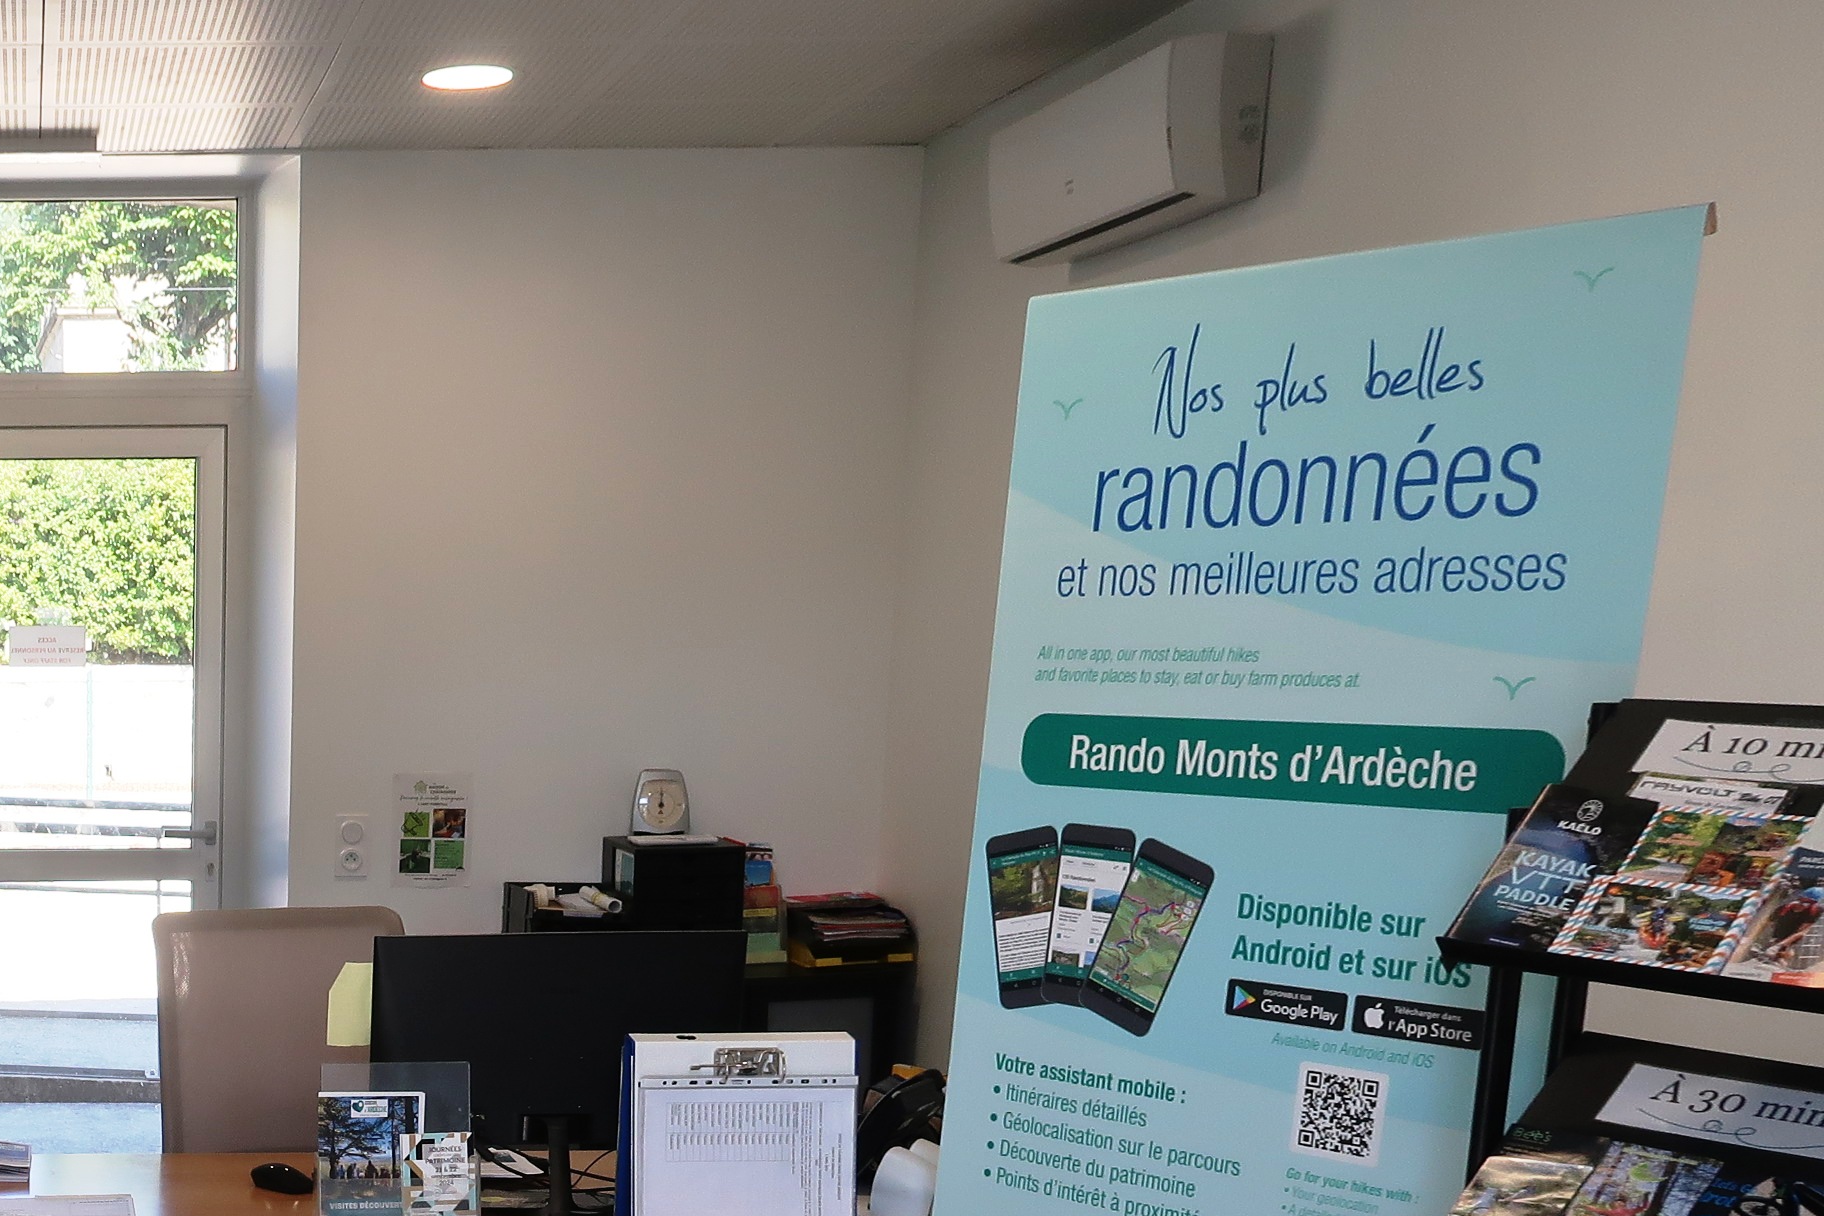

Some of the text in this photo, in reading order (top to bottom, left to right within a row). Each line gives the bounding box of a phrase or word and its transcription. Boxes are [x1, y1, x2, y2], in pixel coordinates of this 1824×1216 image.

[1151, 323, 1484, 438] Nos plus belles
[1092, 423, 1541, 532] randonnées
[1057, 547, 1567, 598] et nos meilleures adresses
[1037, 645, 1260, 664] All in one app, our most beautiful hikes
[1035, 667, 1057, 682] and
[1058, 667, 1098, 683] favorite
[1100, 668, 1136, 685] places
[1139, 669, 1150, 684] to
[1183, 670, 1203, 685] eat
[1205, 671, 1219, 685] or
[1221, 670, 1245, 688] buy
[1247, 670, 1278, 687] farm
[1280, 671, 1341, 689] produces
[1682, 725, 1716, 753] À
[1721, 737, 1769, 756] 10
[1069, 734, 1477, 792] Rando Monts d'Ardèche
[1557, 820, 1602, 836] KAÉLO
[1514, 850, 1597, 878] KAYAK
[1512, 866, 1588, 894] VTT
[1493, 884, 1575, 911] PADDLE
[1237, 893, 1425, 938] Disponible sur
[1231, 935, 1472, 988] Android et sur iOS
[1260, 999, 1338, 1026] Google Play
[1394, 1005, 1440, 1021] Télécharger
[1271, 1032, 1320, 1052] Available
[1323, 1042, 1338, 1056] on
[1339, 1042, 1384, 1062] Android
[1386, 1047, 1411, 1064] and
[1430, 1024, 1473, 1043] Store
[996, 1052, 1035, 1076] Votre
[1039, 1064, 1113, 1091] assistant
[1117, 1077, 1175, 1102] mobile
[1006, 1083, 1148, 1128] Itinéraires détaillés
[1650, 1073, 1687, 1105] À
[1688, 1088, 1746, 1114] 30
[1003, 1110, 1241, 1177] Géolocalisation sur le parcours
[999, 1139, 1196, 1199] Découverte du patrimoine
[1286, 1167, 1301, 1181] Go
[1304, 1171, 1321, 1183] for
[1321, 1176, 1348, 1190] your
[1350, 1180, 1383, 1197] hikes
[996, 1167, 1039, 1193] Points
[1043, 1178, 1107, 1209] d'intérêt
[1110, 1192, 1120, 1212] à
[1316, 1193, 1379, 1214] geolocation
[329, 1201, 358, 1210] VISITES
